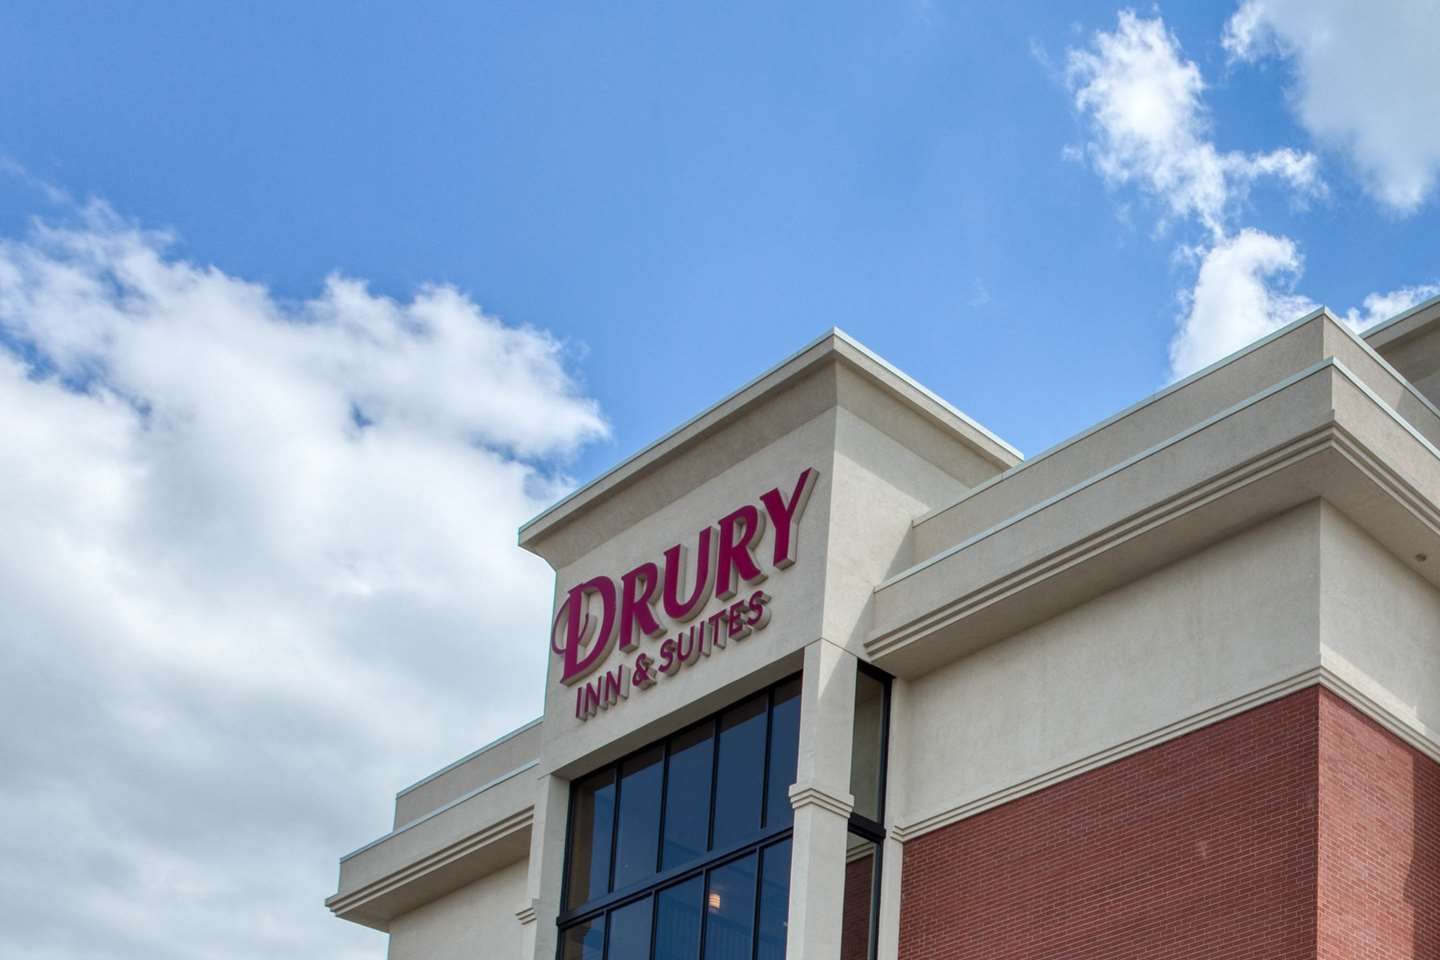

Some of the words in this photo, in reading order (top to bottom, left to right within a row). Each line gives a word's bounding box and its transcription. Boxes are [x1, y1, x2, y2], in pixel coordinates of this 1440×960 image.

[551, 467, 818, 687] DRURY
[575, 664, 630, 721] INN
[632, 652, 657, 690] &
[658, 590, 771, 676] SUITES
